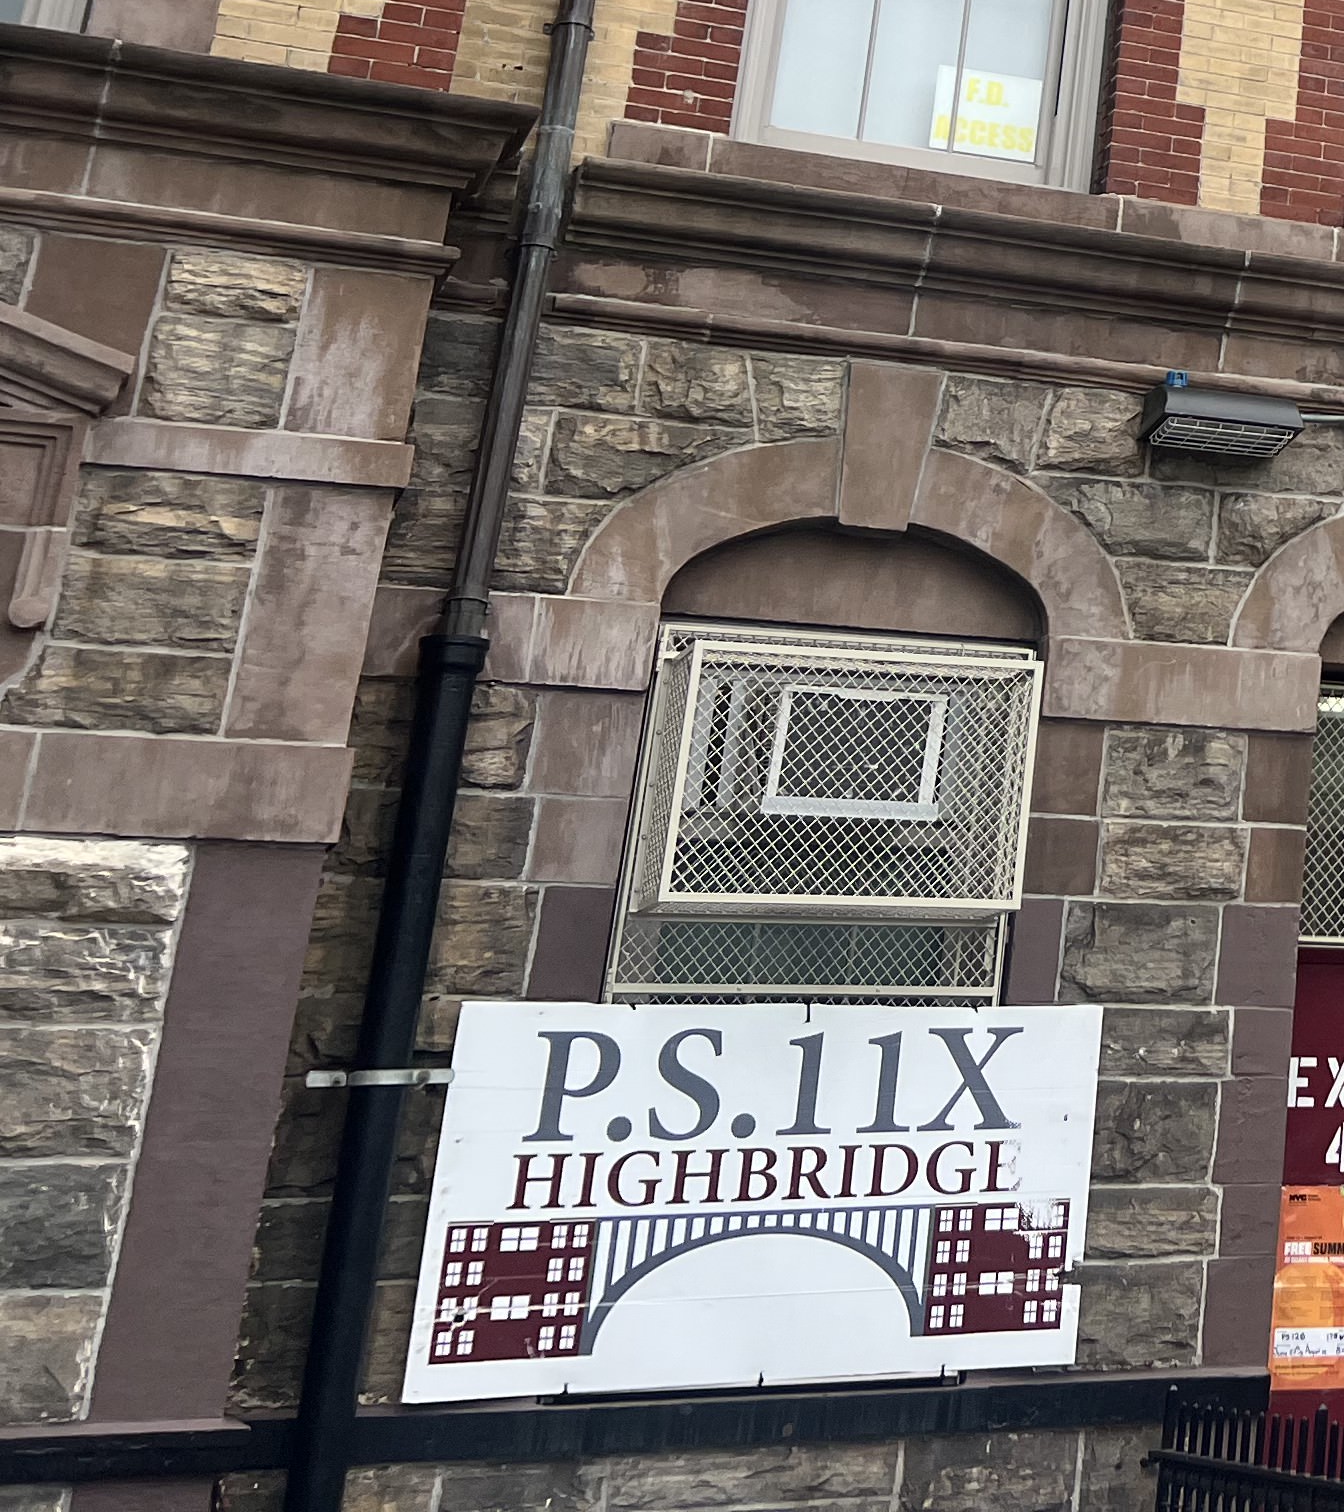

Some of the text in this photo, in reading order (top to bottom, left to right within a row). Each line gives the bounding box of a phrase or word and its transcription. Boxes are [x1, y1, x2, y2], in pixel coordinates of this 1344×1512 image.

[966, 76, 1009, 108] F.D.
[934, 114, 1033, 153] ACCESS
[505, 1140, 1022, 1211] HIGHBRIDGE
